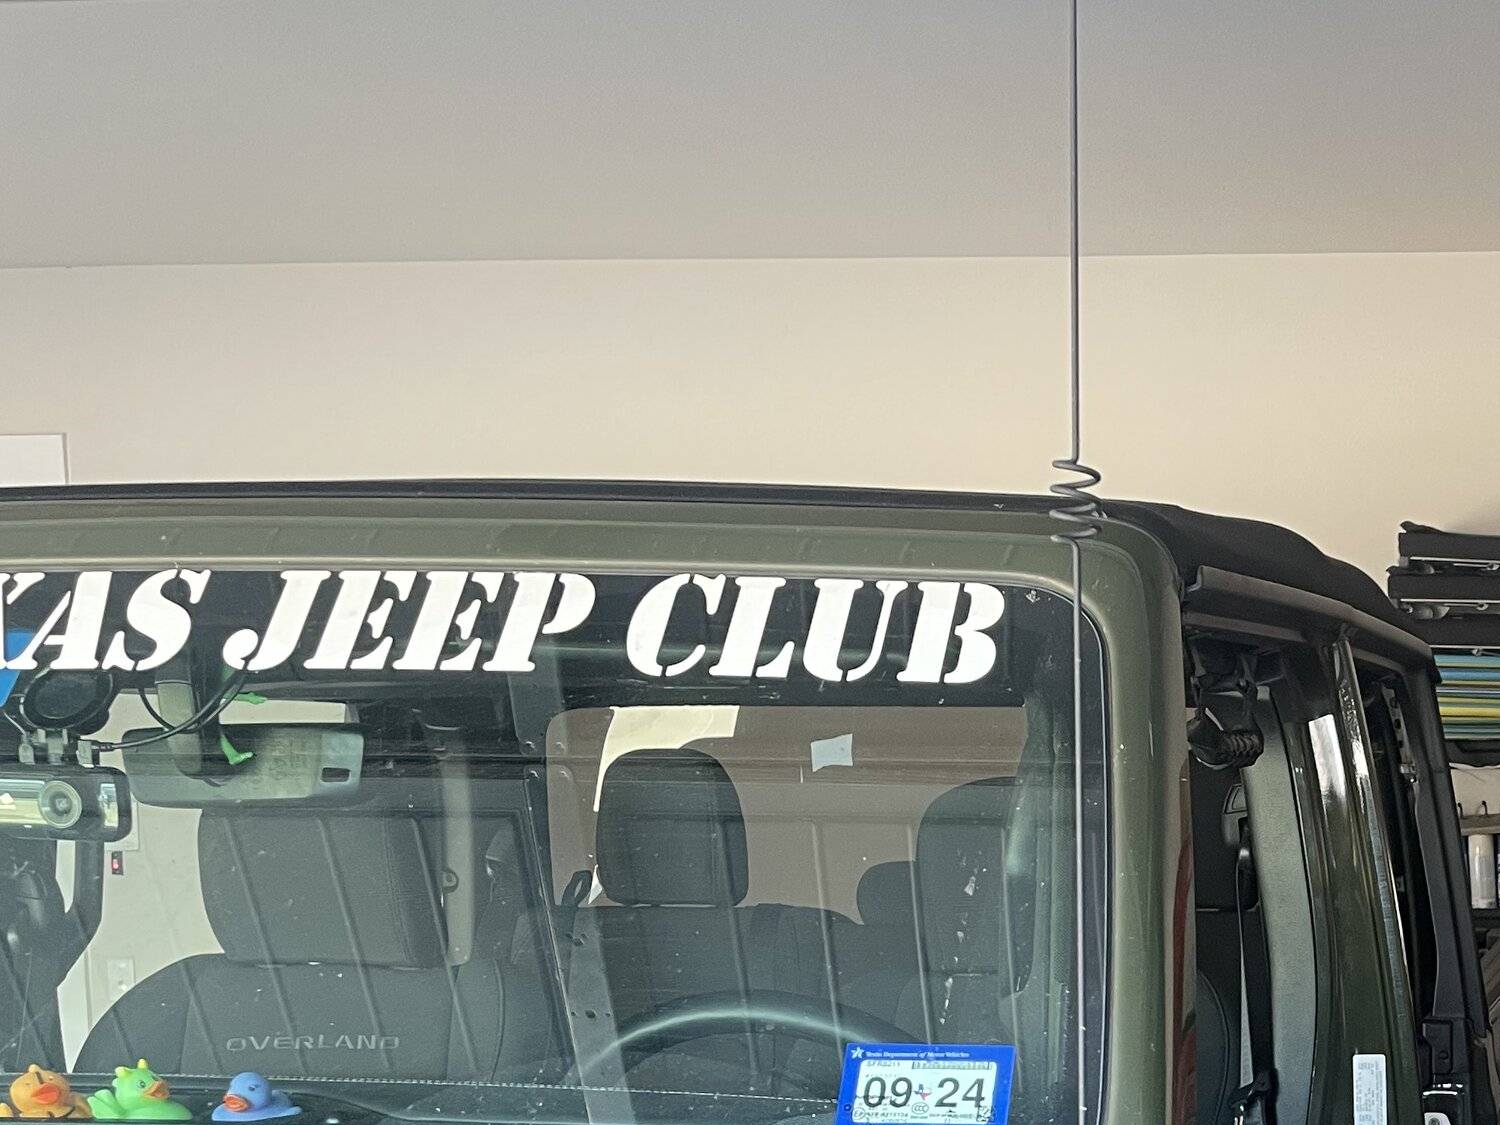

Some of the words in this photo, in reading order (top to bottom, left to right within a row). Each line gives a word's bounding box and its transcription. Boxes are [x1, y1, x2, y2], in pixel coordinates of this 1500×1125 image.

[222, 569, 597, 672] JEEP
[626, 573, 1006, 684] CLUB
[226, 1034, 400, 1051] OVERLAND
[863, 1077, 912, 1108] 09
[935, 1077, 985, 1108] 24
